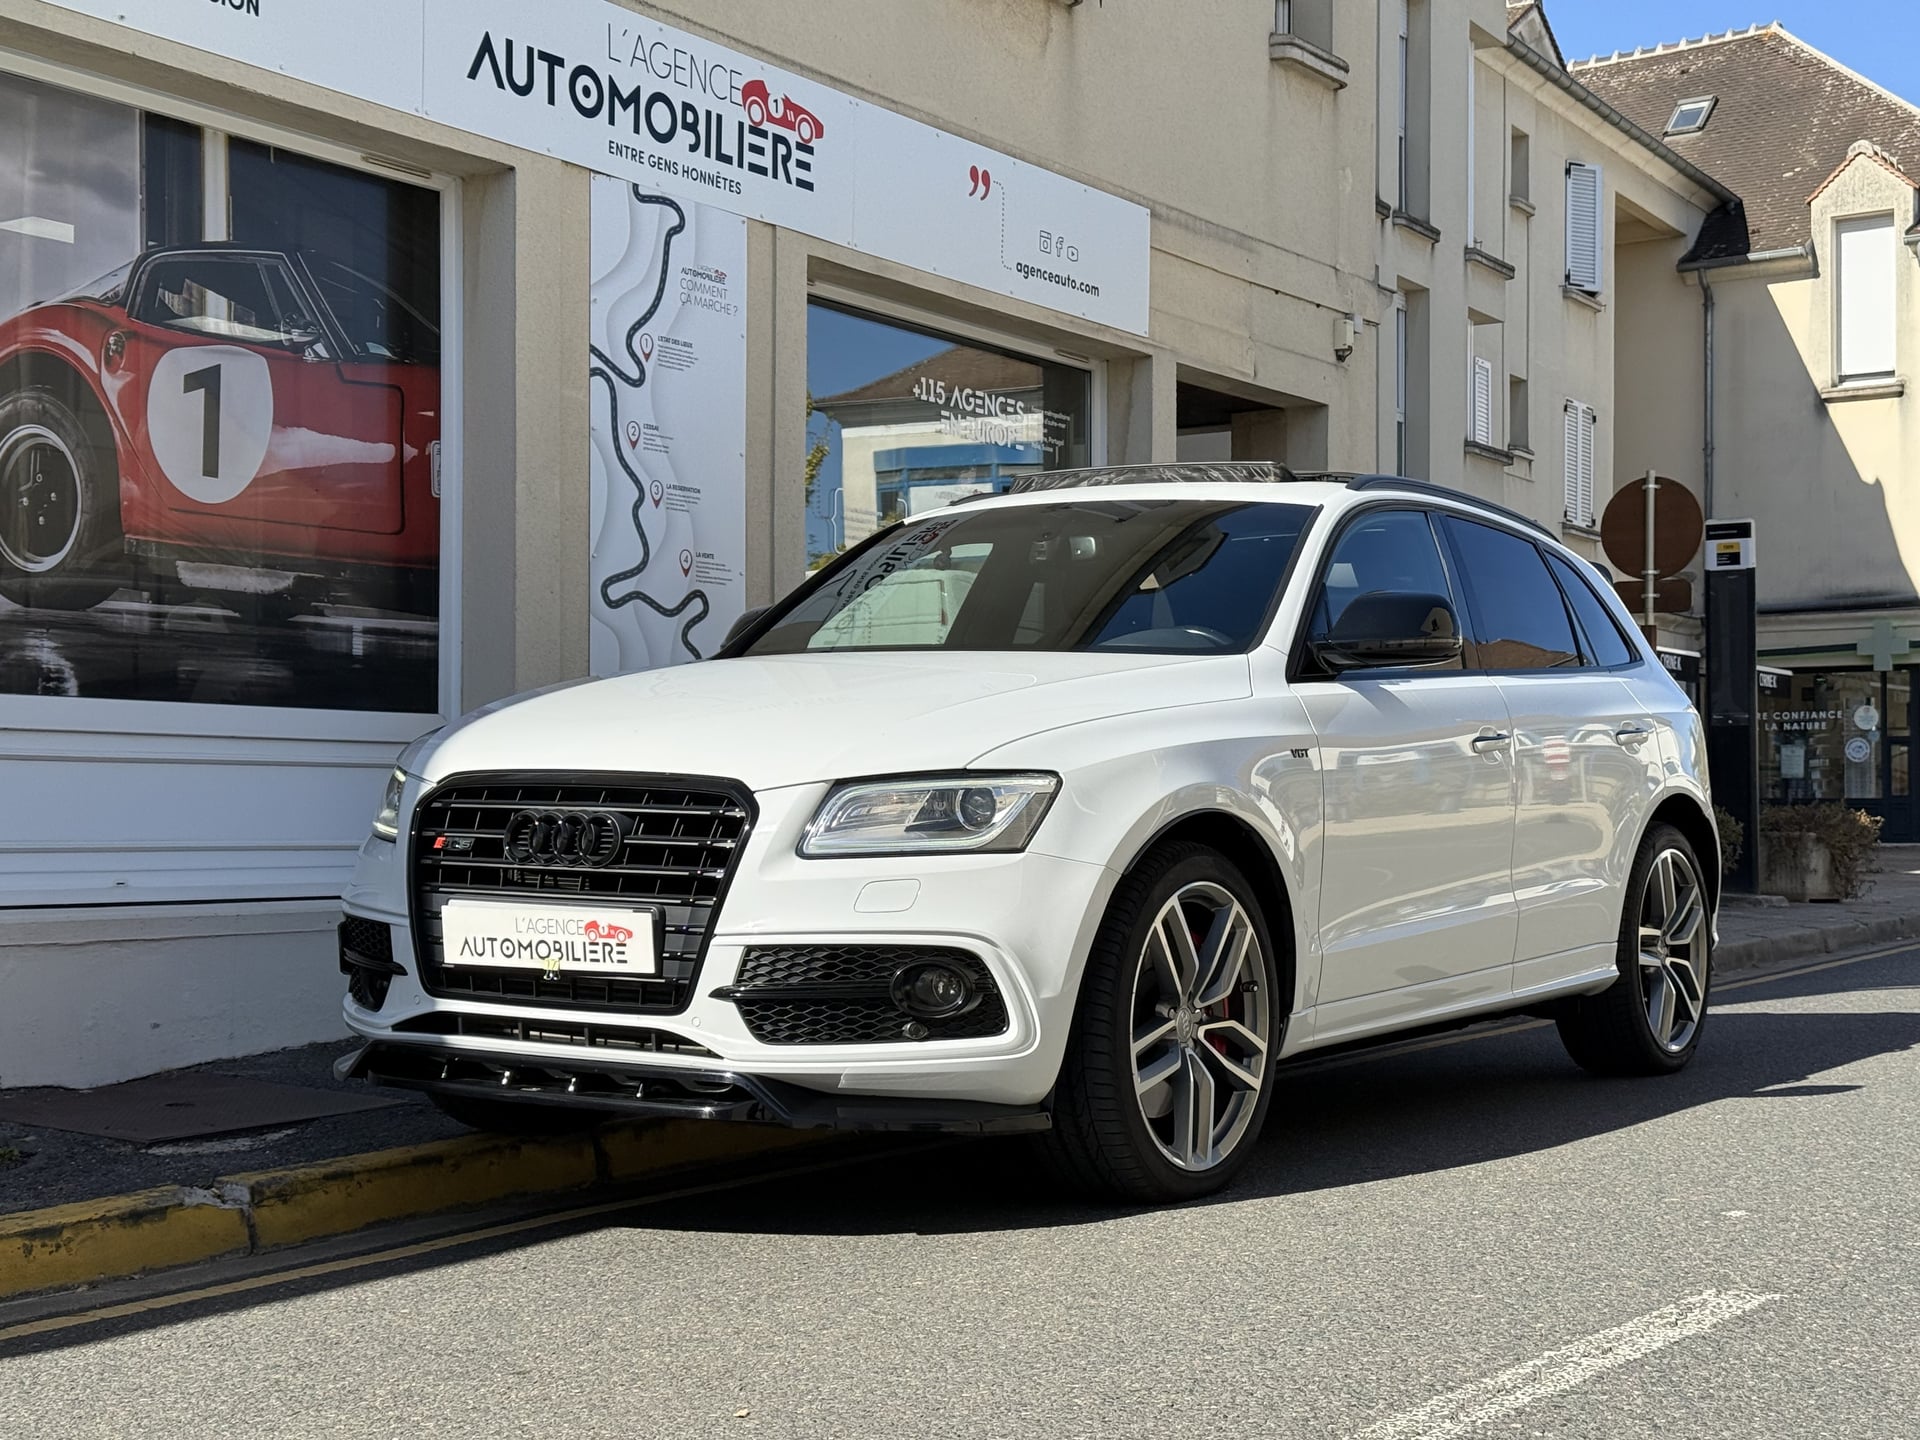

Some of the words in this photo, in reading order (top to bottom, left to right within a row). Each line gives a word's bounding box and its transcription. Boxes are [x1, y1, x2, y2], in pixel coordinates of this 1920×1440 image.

[607, 22, 743, 107] L'AGENCE
[467, 31, 815, 192] AUTOMOBILIERE
[608, 140, 645, 165] ENTRE
[648, 153, 679, 176] GENS
[681, 164, 742, 195] HONNÊTES
[679, 277, 728, 300] COMMENT
[1015, 261, 1100, 297] agenceauto.com
[679, 291, 692, 307] ÇA
[693, 295, 732, 316] MARCHE
[912, 376, 946, 405] +115
[950, 384, 1025, 423] AGENCES
[184, 363, 222, 479] 1
[630, 425, 637, 436] 2
[653, 484, 660, 496] 3
[683, 554, 689, 564] 4
[1772, 710, 1843, 721] CONFIANCE
[1783, 721, 1827, 731] NATURE
[515, 916, 585, 936] L'AGENCE
[460, 936, 628, 964] AUTOMOBILIERE
